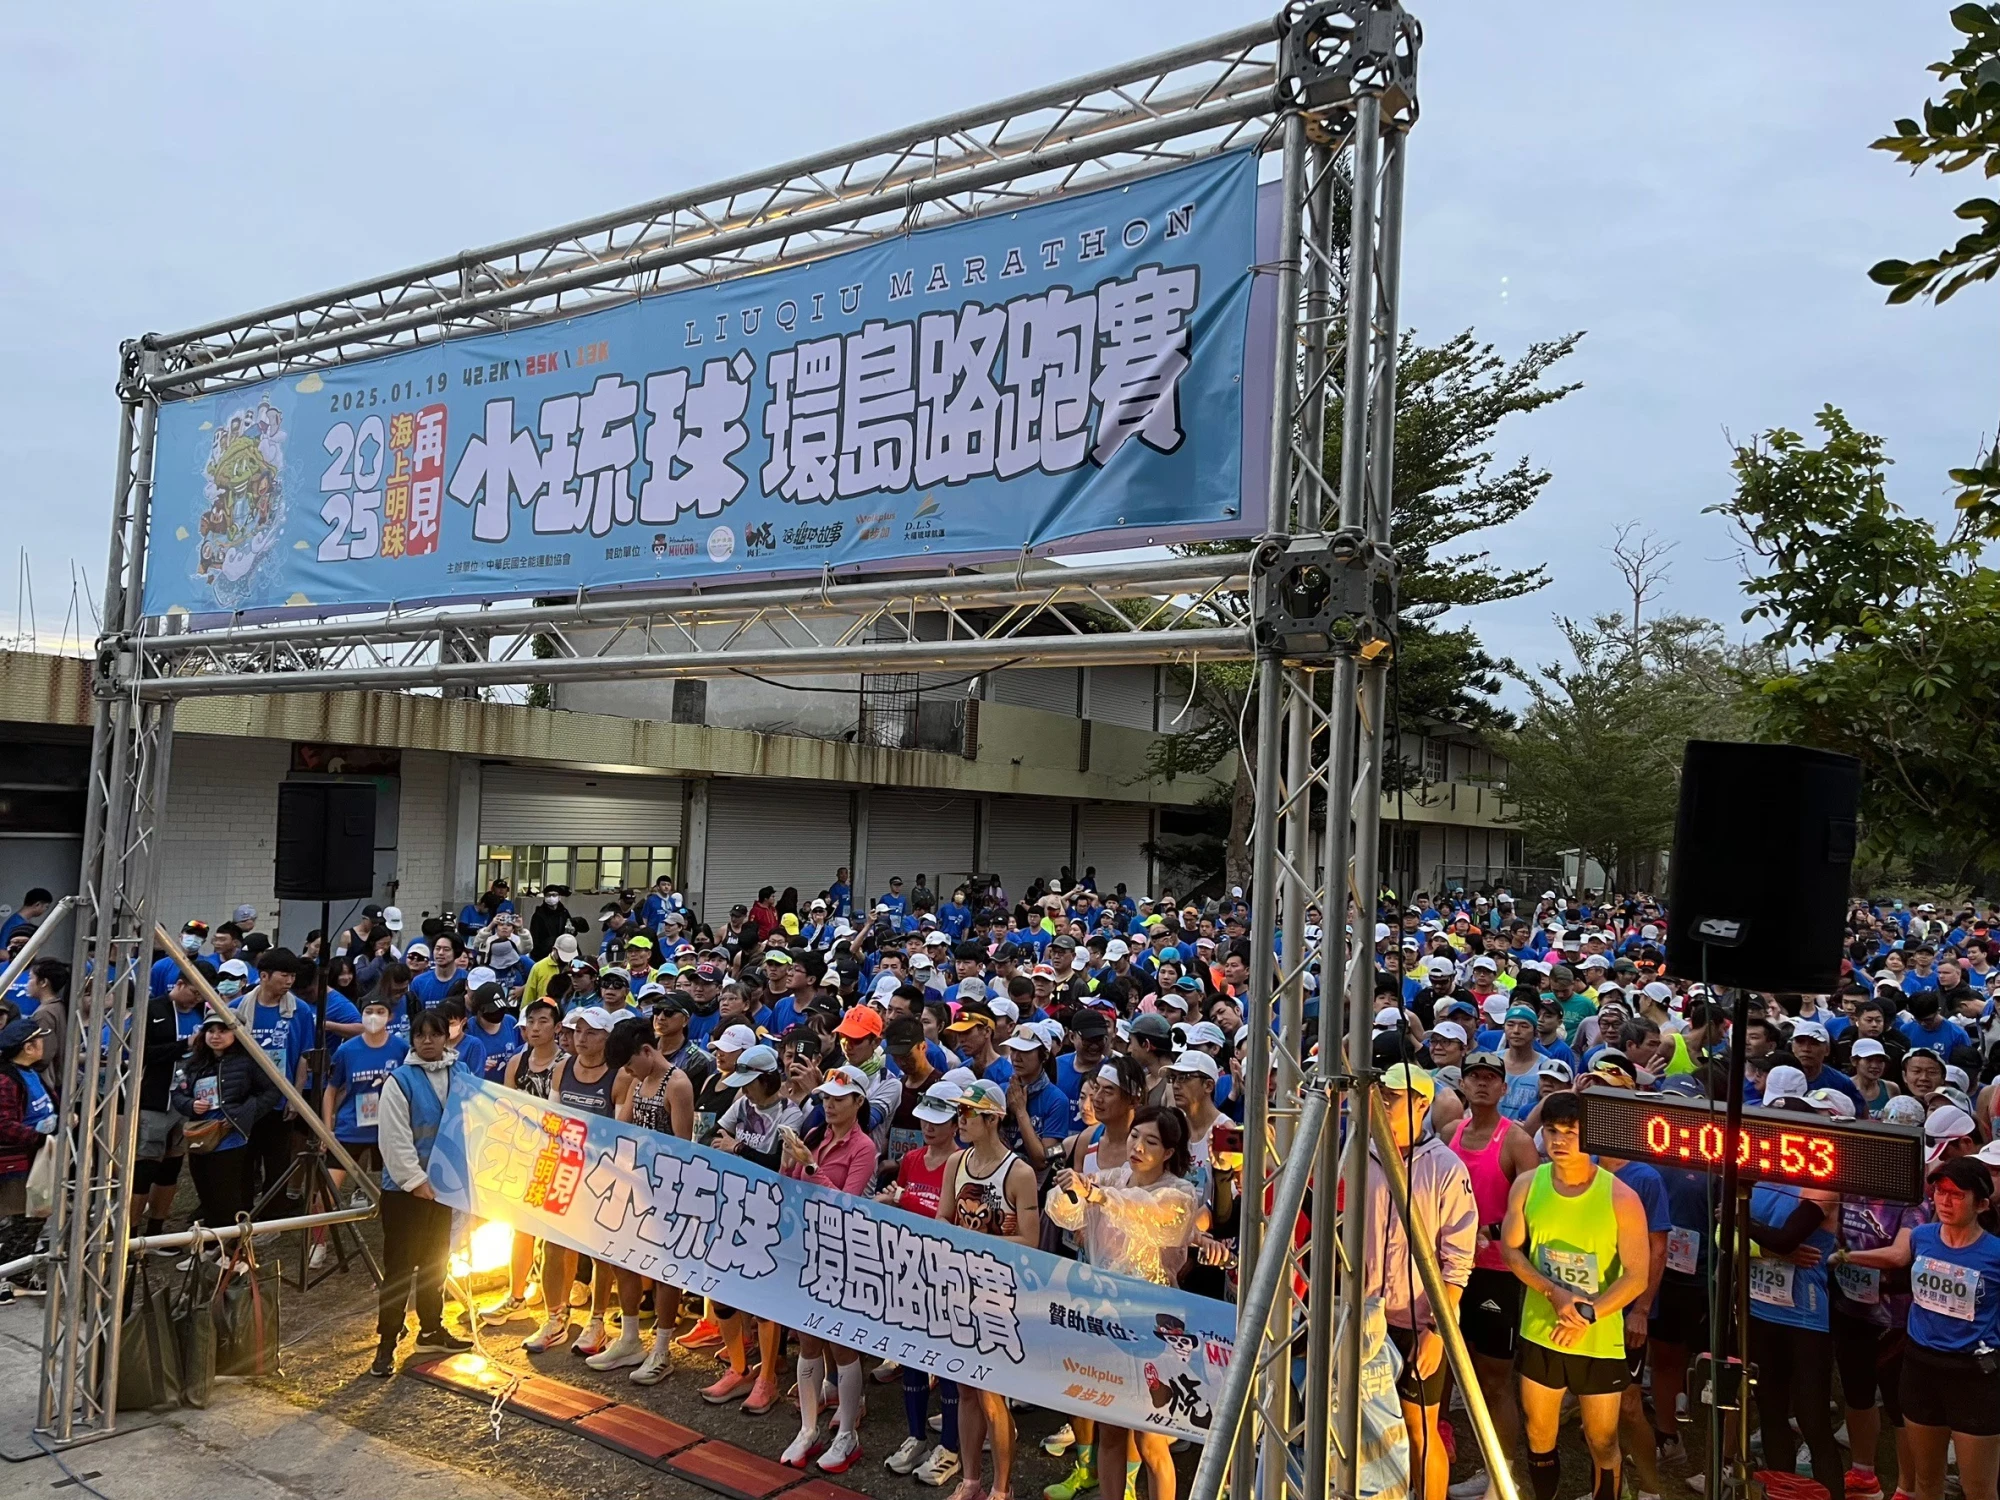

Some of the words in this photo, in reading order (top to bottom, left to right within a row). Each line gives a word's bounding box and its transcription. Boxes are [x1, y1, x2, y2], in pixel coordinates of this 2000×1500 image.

[684, 285, 862, 348] LIUQIU
[888, 203, 1197, 301] MARATHON
[463, 361, 510, 387] 42.2K
[526, 351, 559, 376] 25K
[576, 341, 609, 368] 13K
[330, 372, 448, 413] 2025.01.19
[446, 348, 755, 544] 小琉球
[761, 262, 1201, 503] 環島路跑賽
[320, 414, 386, 492] 20
[379, 411, 415, 559] 海上明珠
[316, 490, 382, 563] 25
[905, 519, 932, 531] D.L.S
[668, 543, 695, 557] MUCHO
[562, 1093, 604, 1107] PACER
[523, 1110, 565, 1208] 海上明珠
[584, 1135, 784, 1280] 小琉球
[798, 1198, 1026, 1365] 環島路跑賽
[1543, 1262, 1590, 1286] 3152
[1750, 1265, 1785, 1288] 3129
[1917, 1272, 1967, 1298] 4080
[599, 1240, 721, 1294] LIUQIU
[803, 1312, 994, 1382] MARATHON
[1062, 1356, 1125, 1386] Walkplus
